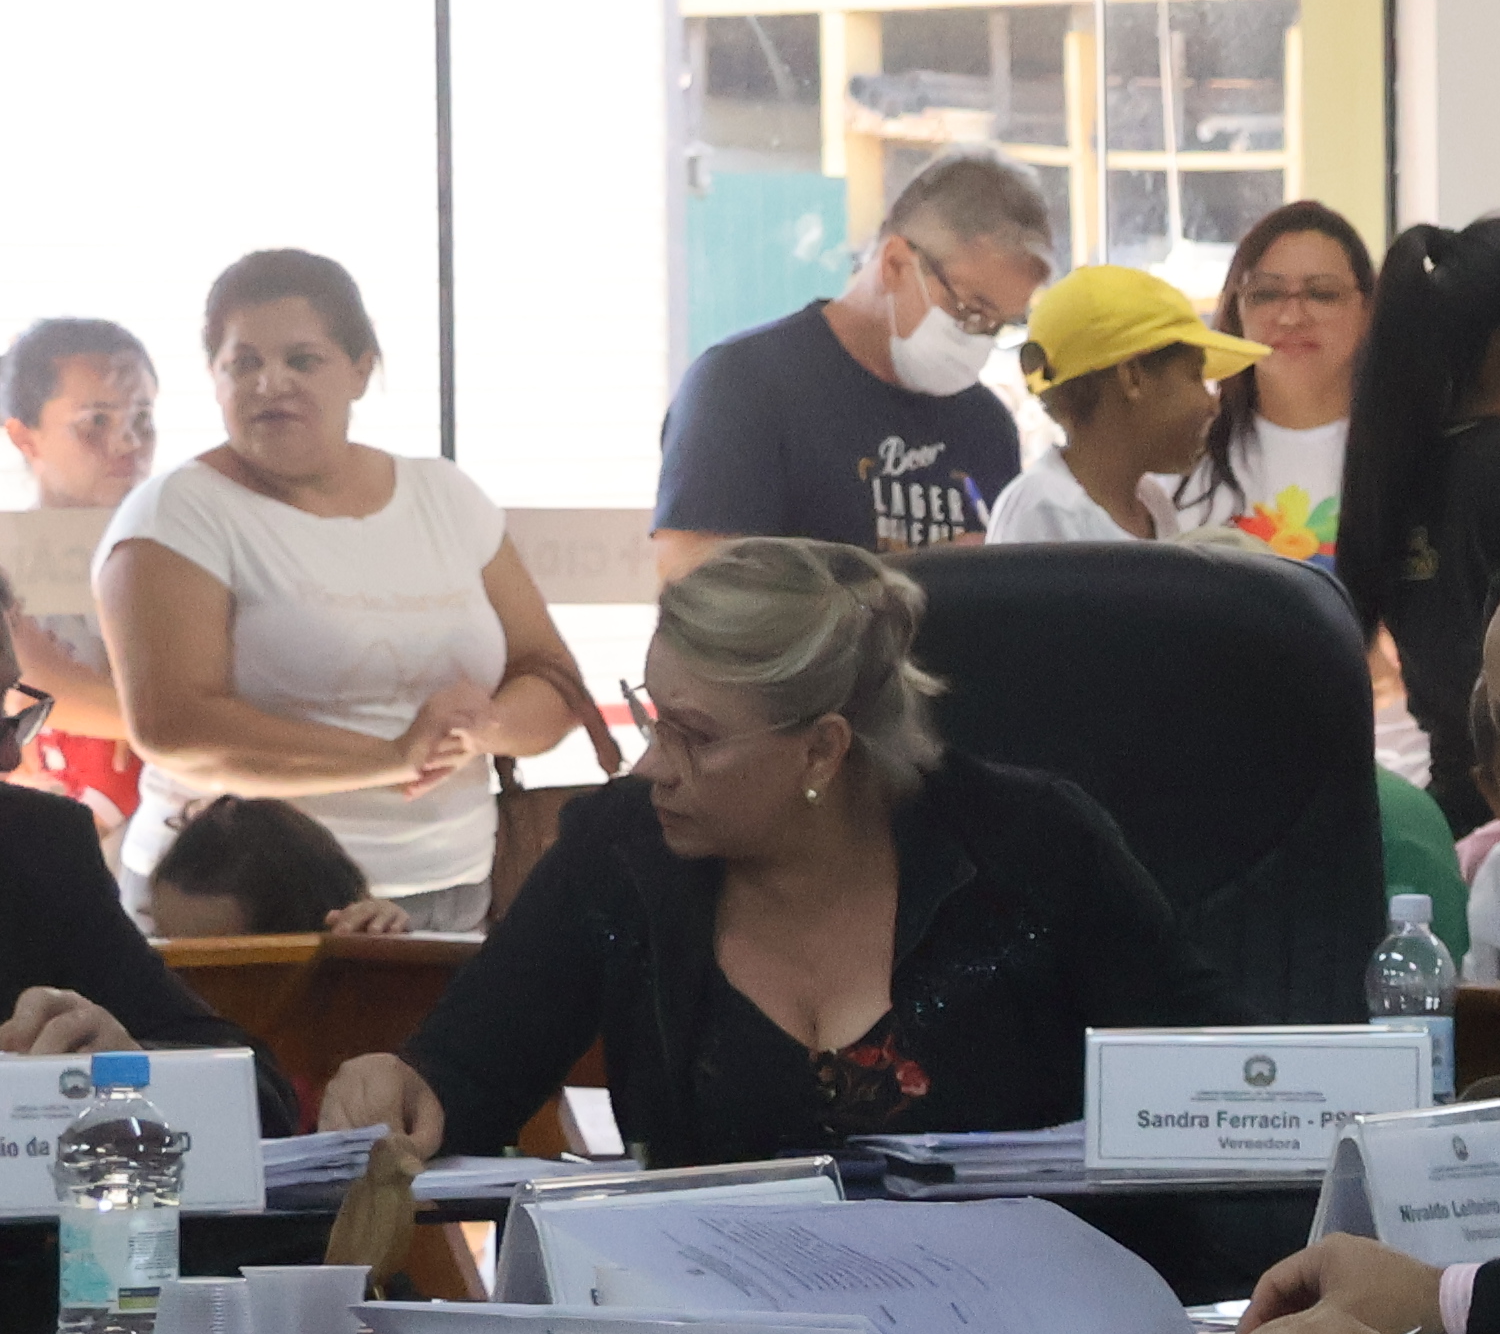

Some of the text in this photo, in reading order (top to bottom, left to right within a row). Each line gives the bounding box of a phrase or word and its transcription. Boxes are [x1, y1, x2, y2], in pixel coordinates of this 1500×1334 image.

[871, 476, 965, 523] LAGER
[1137, 1109, 1210, 1129] Sandra
[1215, 1109, 1301, 1130] Ferracin
[26, 1136, 51, 1158] da
